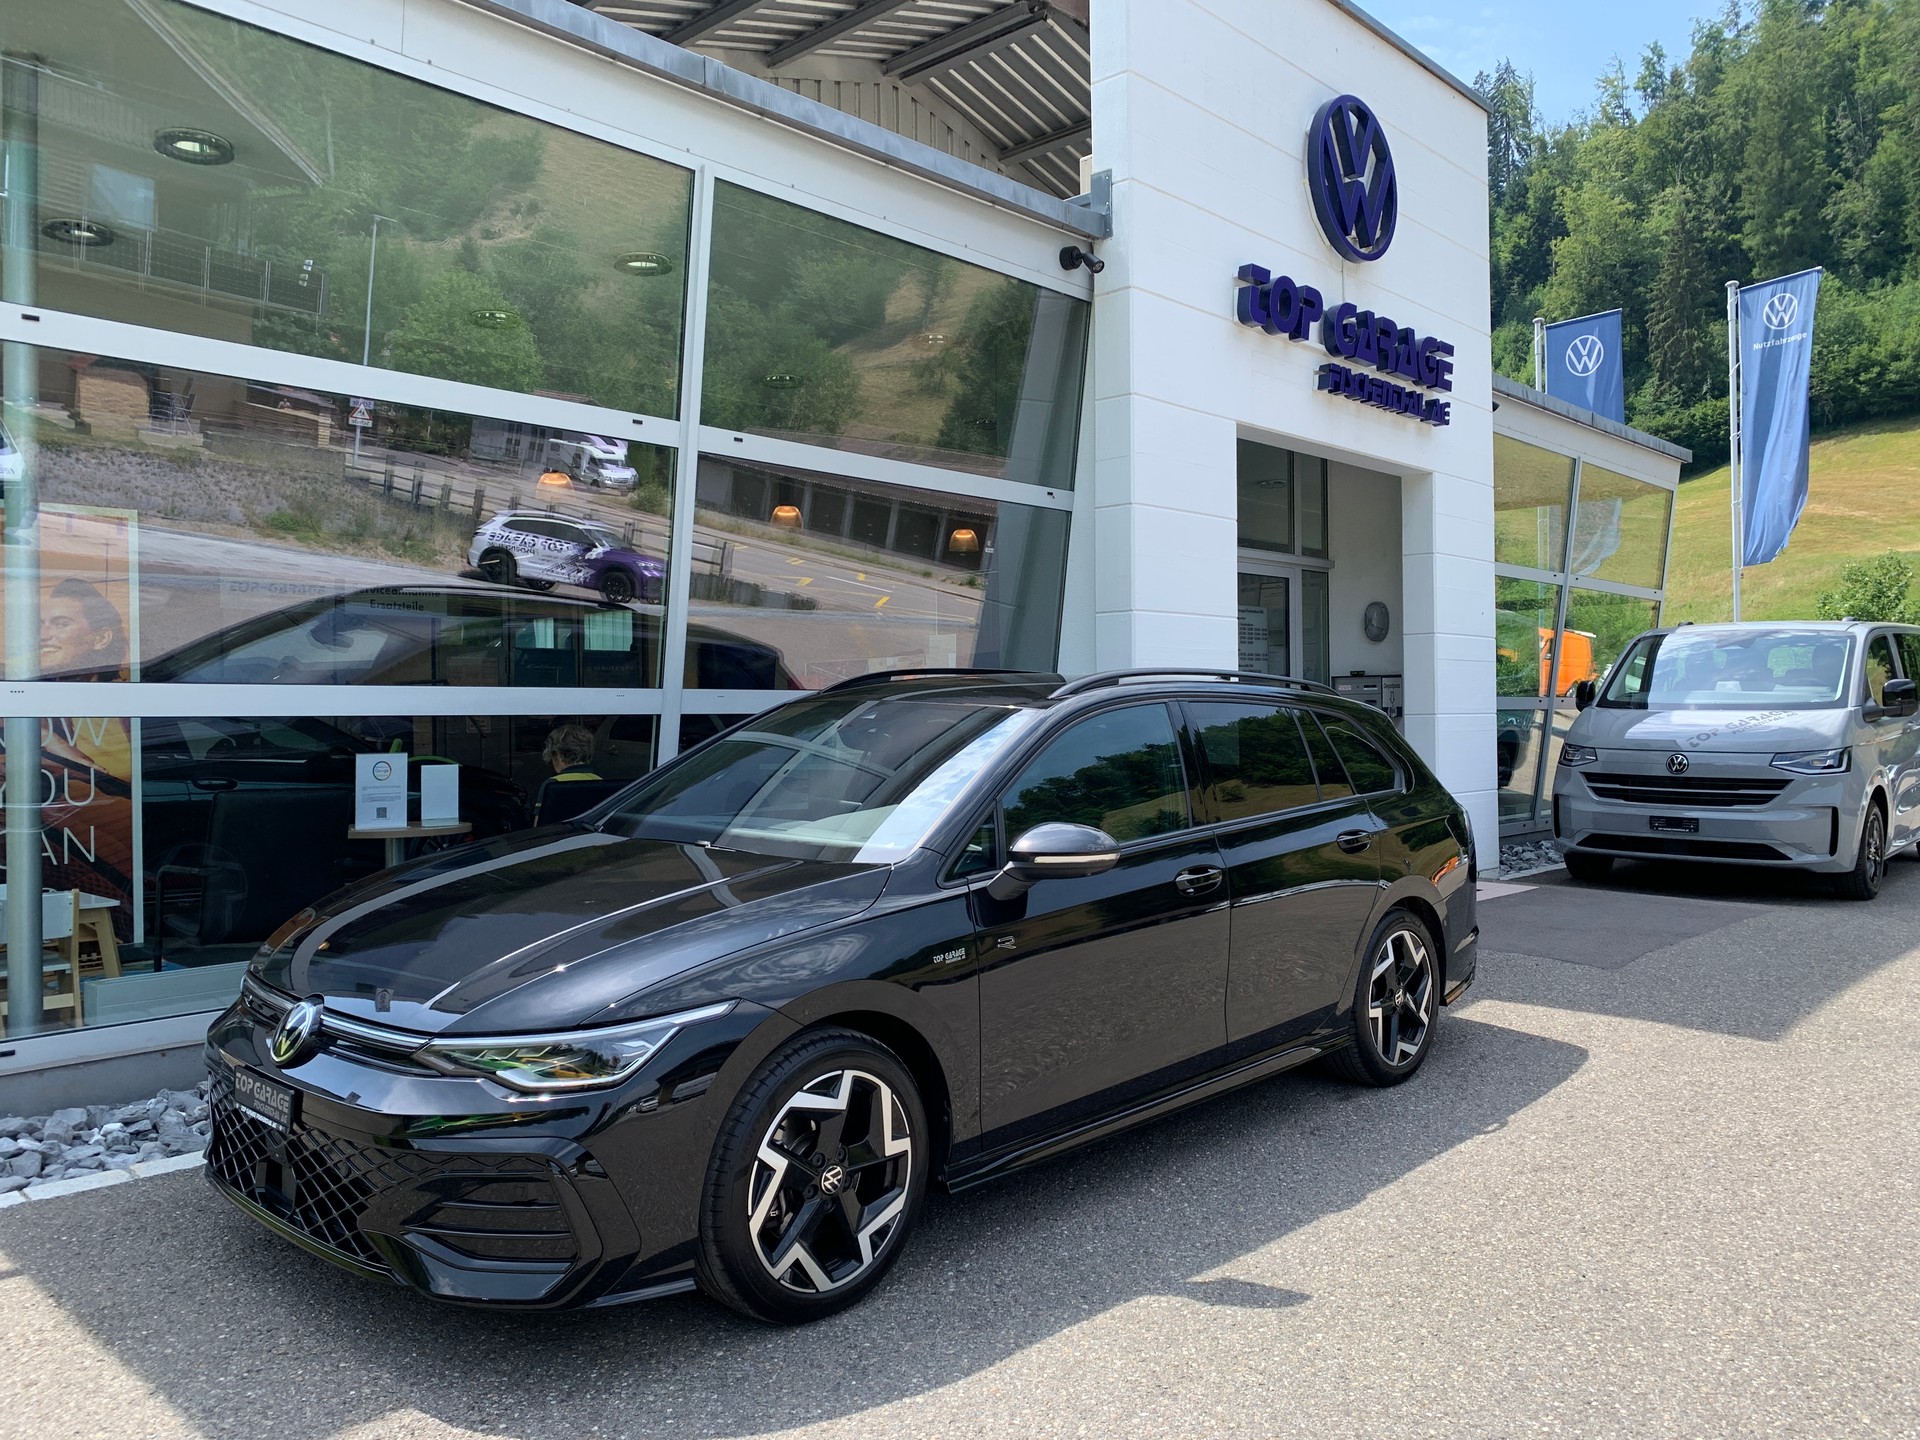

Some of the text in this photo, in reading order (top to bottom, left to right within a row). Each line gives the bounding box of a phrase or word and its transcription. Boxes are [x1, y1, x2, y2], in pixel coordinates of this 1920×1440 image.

[1237, 263, 1454, 394] TOP GARAGE
[369, 598, 425, 612] Ersatzteile
[933, 954, 944, 964] TOP
[944, 947, 965, 960] GARAGE
[235, 1072, 290, 1113] TOP GARAGE
